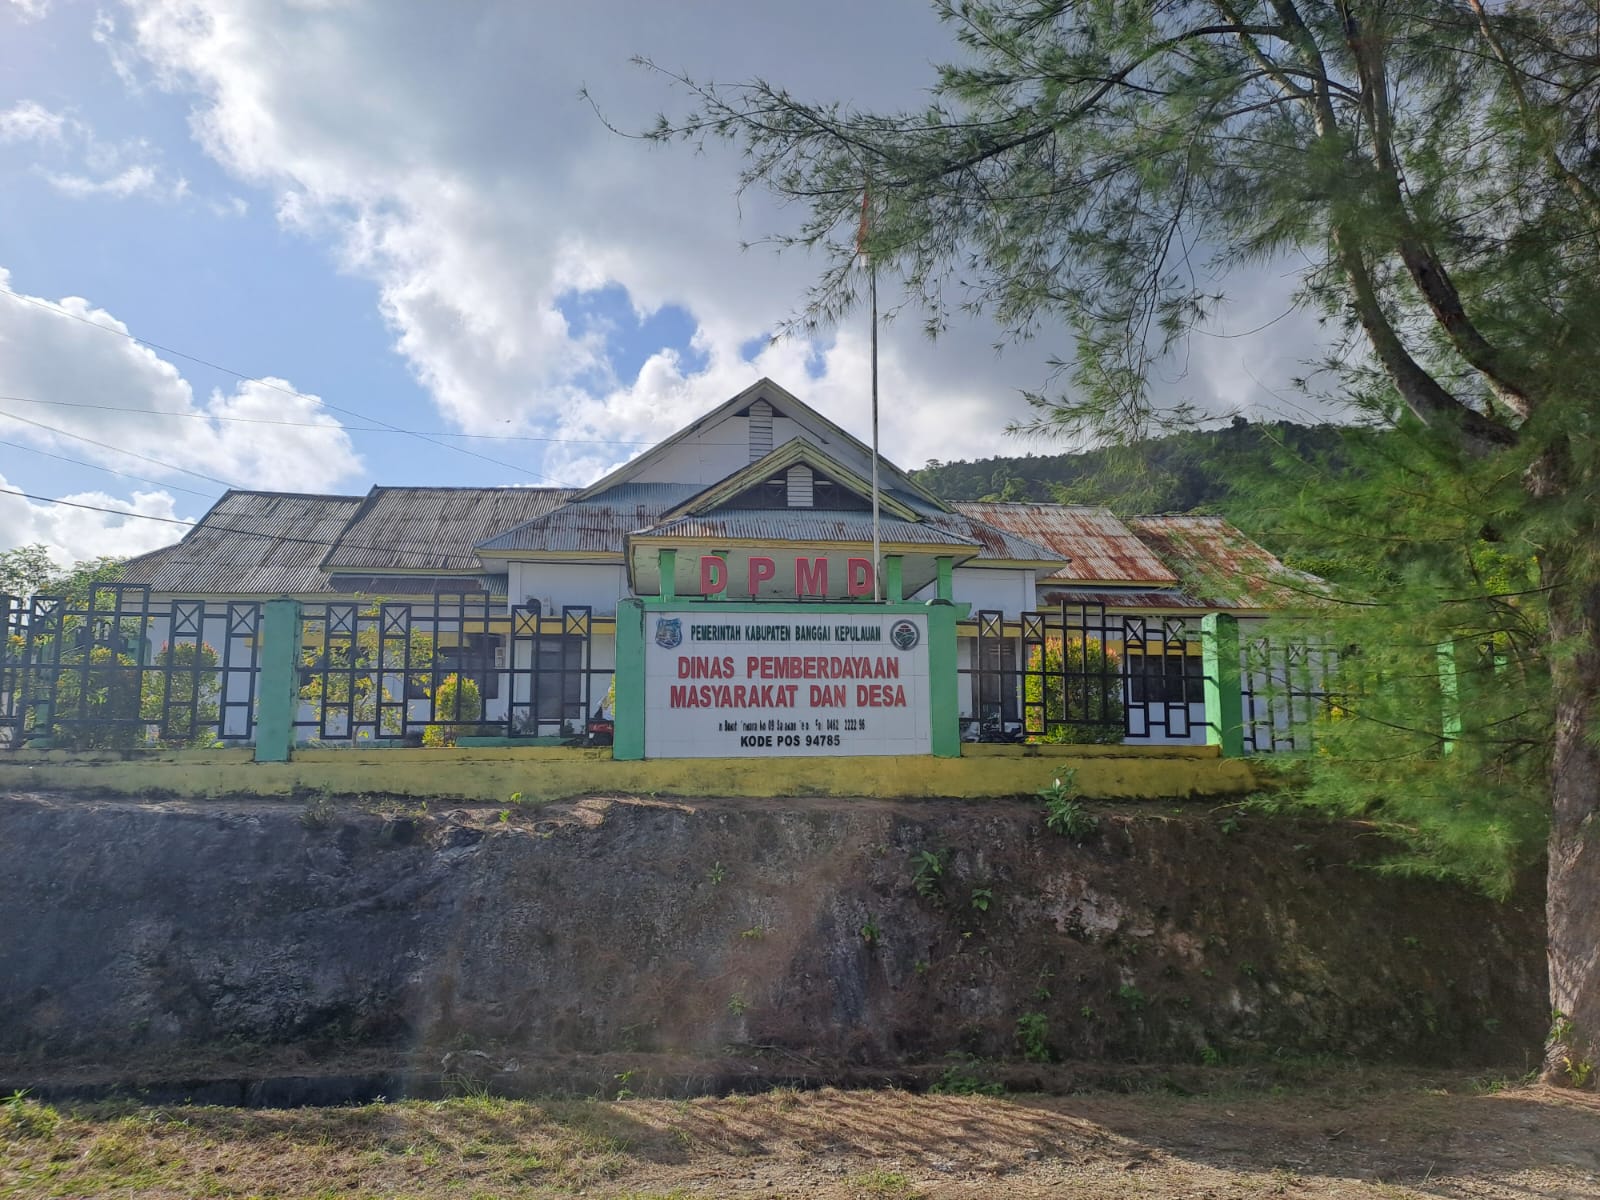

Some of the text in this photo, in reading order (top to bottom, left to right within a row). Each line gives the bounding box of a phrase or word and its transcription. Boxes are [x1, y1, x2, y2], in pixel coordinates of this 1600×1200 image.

[700, 555, 875, 597] DPMD
[691, 625, 881, 642] PEMERINTAH KABUPATEN BANGGAI KEPULAUAN
[678, 656, 899, 679] DINAS PEMBERDAYAAN
[670, 685, 907, 708] MASYARAKAT DAN DESA
[740, 734, 841, 747] KODE POS 94785
